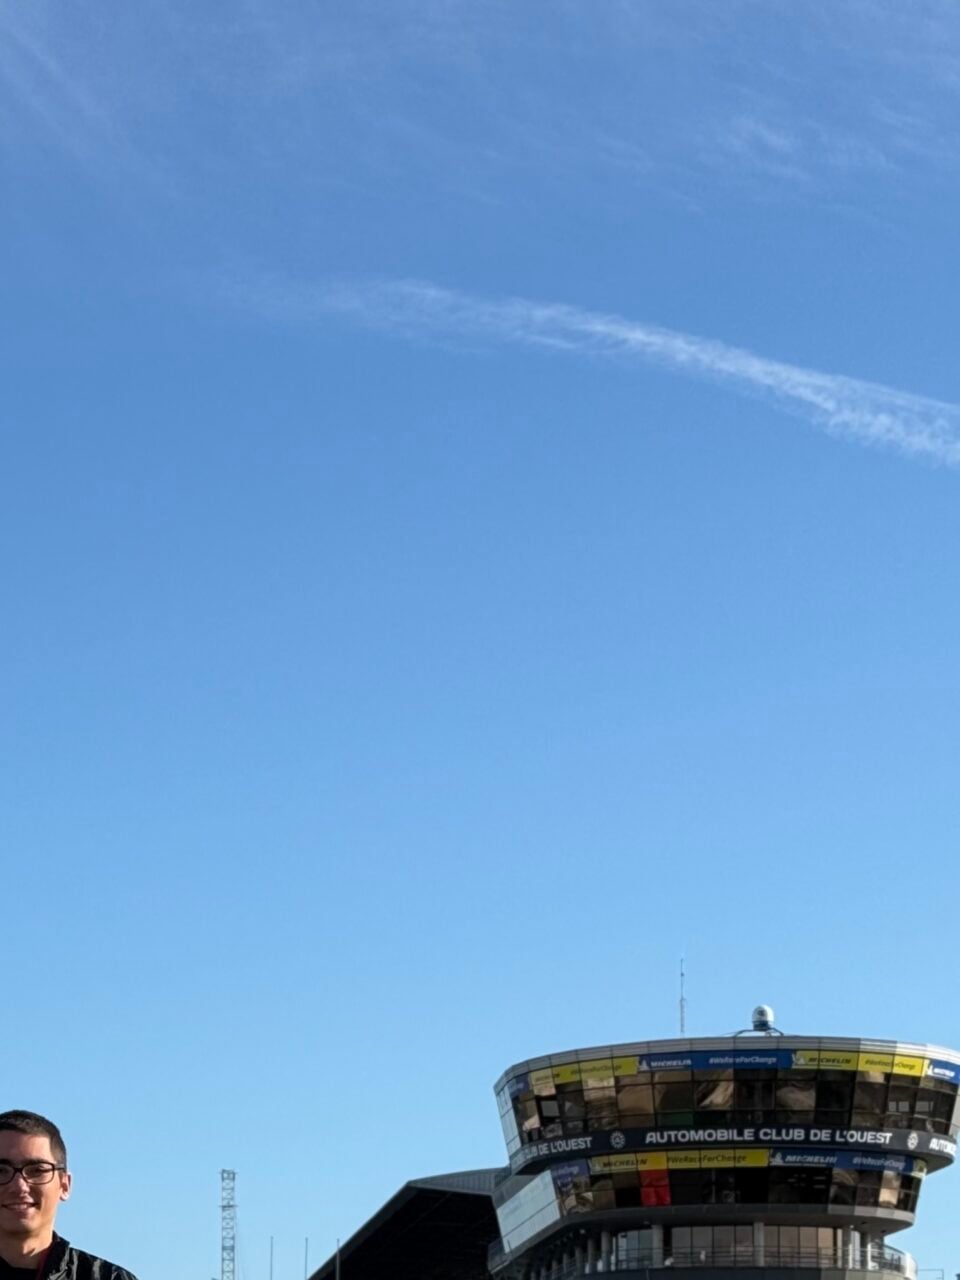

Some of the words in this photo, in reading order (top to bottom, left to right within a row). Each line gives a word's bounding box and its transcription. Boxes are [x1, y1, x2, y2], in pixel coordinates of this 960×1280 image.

[650, 1058, 692, 1067] MICHELIN
[808, 1057, 852, 1065] MICHELIN
[645, 1128, 755, 1144] AUTOMOBILE
[759, 1128, 805, 1141] CLUB
[810, 1129, 831, 1142] DE
[835, 1130, 893, 1144] L'OUEST
[551, 1137, 593, 1154] L'OUEST
[602, 1158, 648, 1168] MICHELIN
[784, 1156, 838, 1164] MICHELIN
